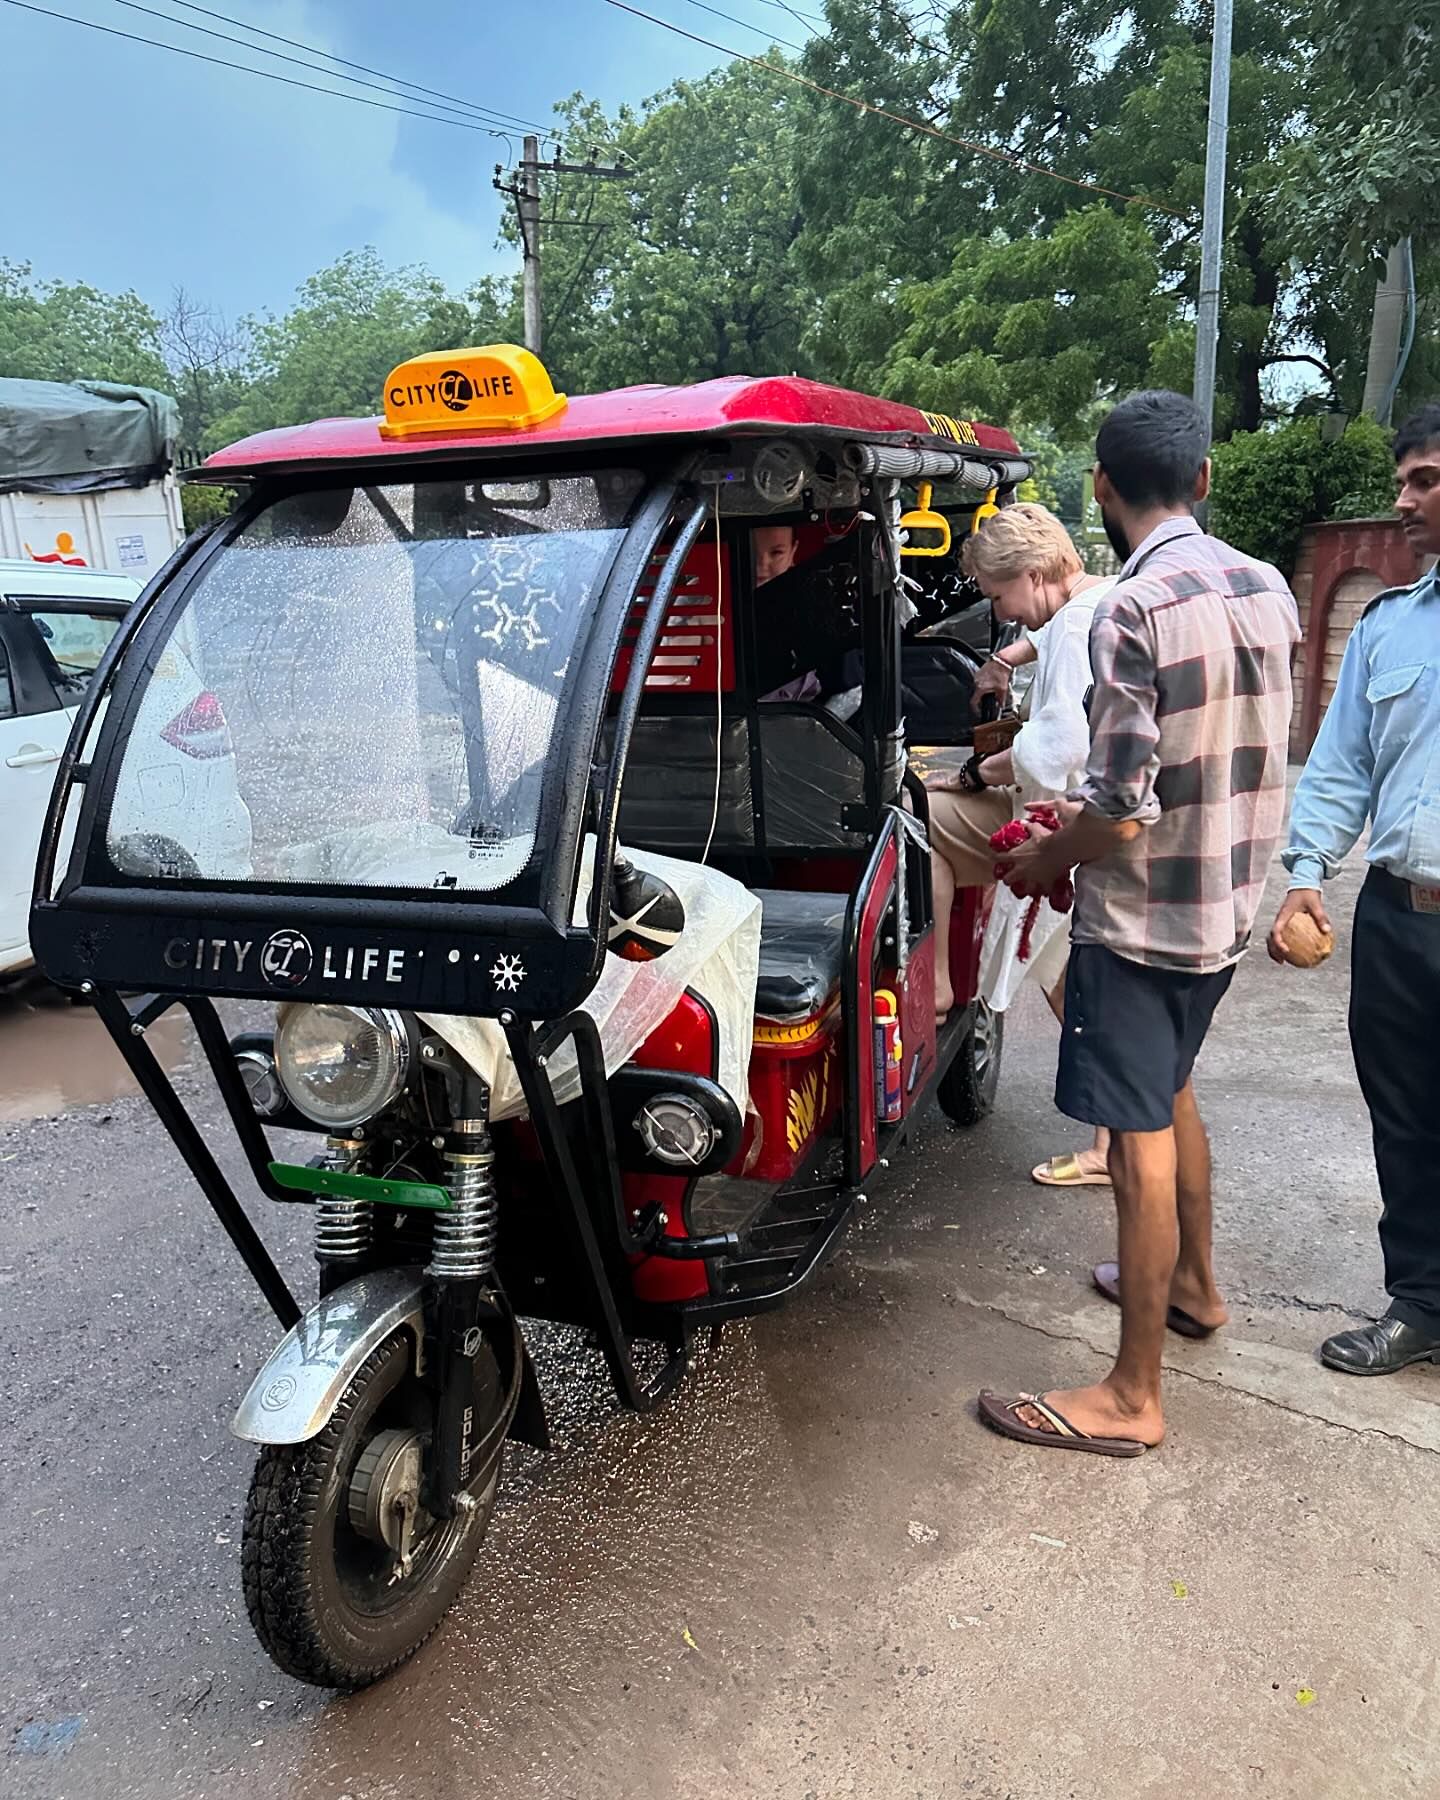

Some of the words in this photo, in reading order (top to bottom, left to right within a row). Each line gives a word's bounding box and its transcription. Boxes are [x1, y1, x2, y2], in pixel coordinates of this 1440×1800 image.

[390, 384, 436, 407] CITY
[472, 375, 513, 398] LIFE
[164, 936, 253, 972] CITY
[322, 945, 406, 982] LIFE
[461, 1406, 473, 1465] GOLD
